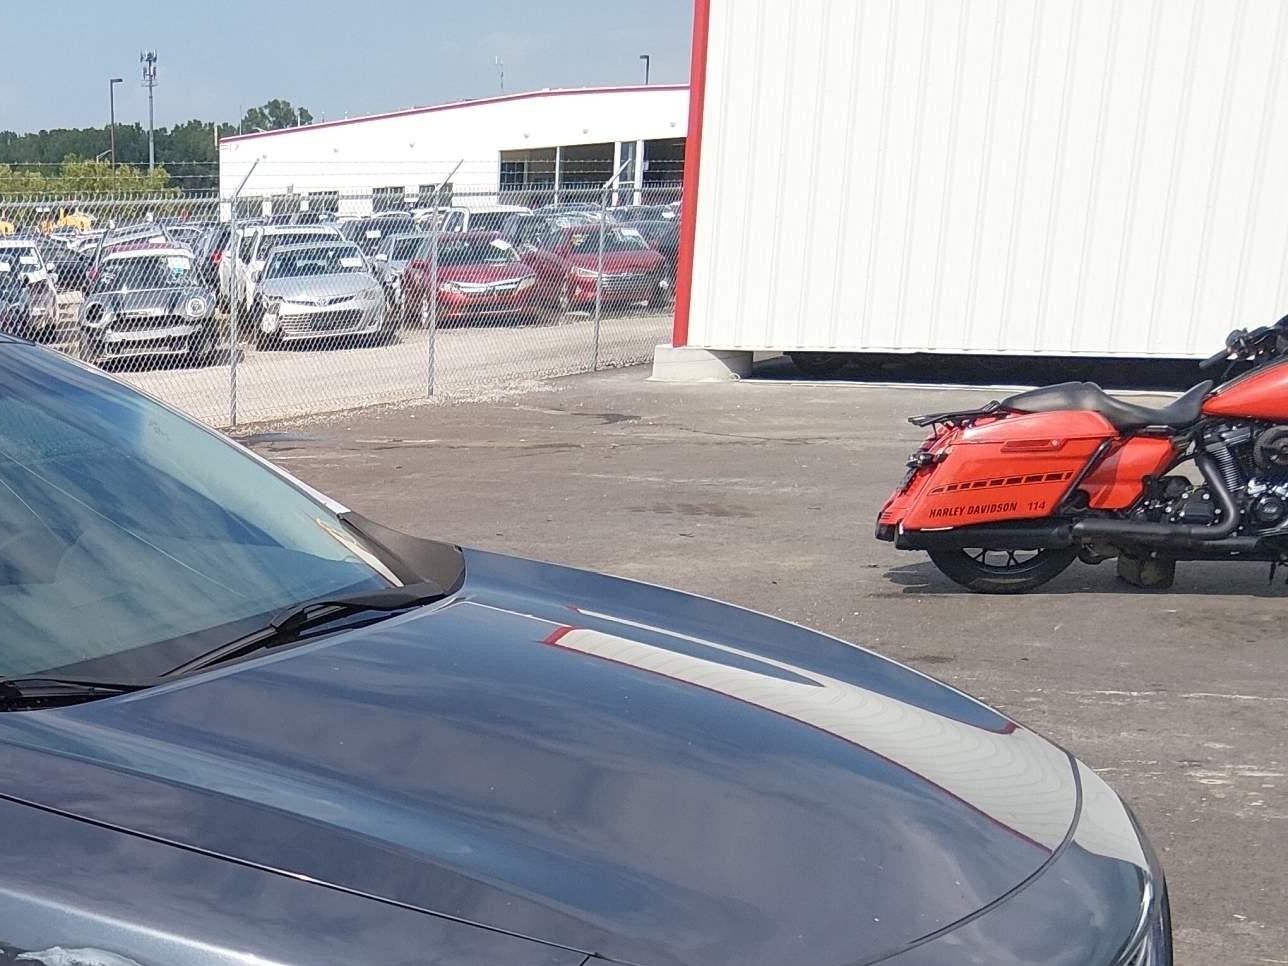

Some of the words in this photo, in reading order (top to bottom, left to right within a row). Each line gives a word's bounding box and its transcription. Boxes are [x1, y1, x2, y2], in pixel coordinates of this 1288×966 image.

[929, 505, 966, 519] HARLEY
[967, 502, 1017, 514] DAVIDSON
[1027, 501, 1047, 511] 114
